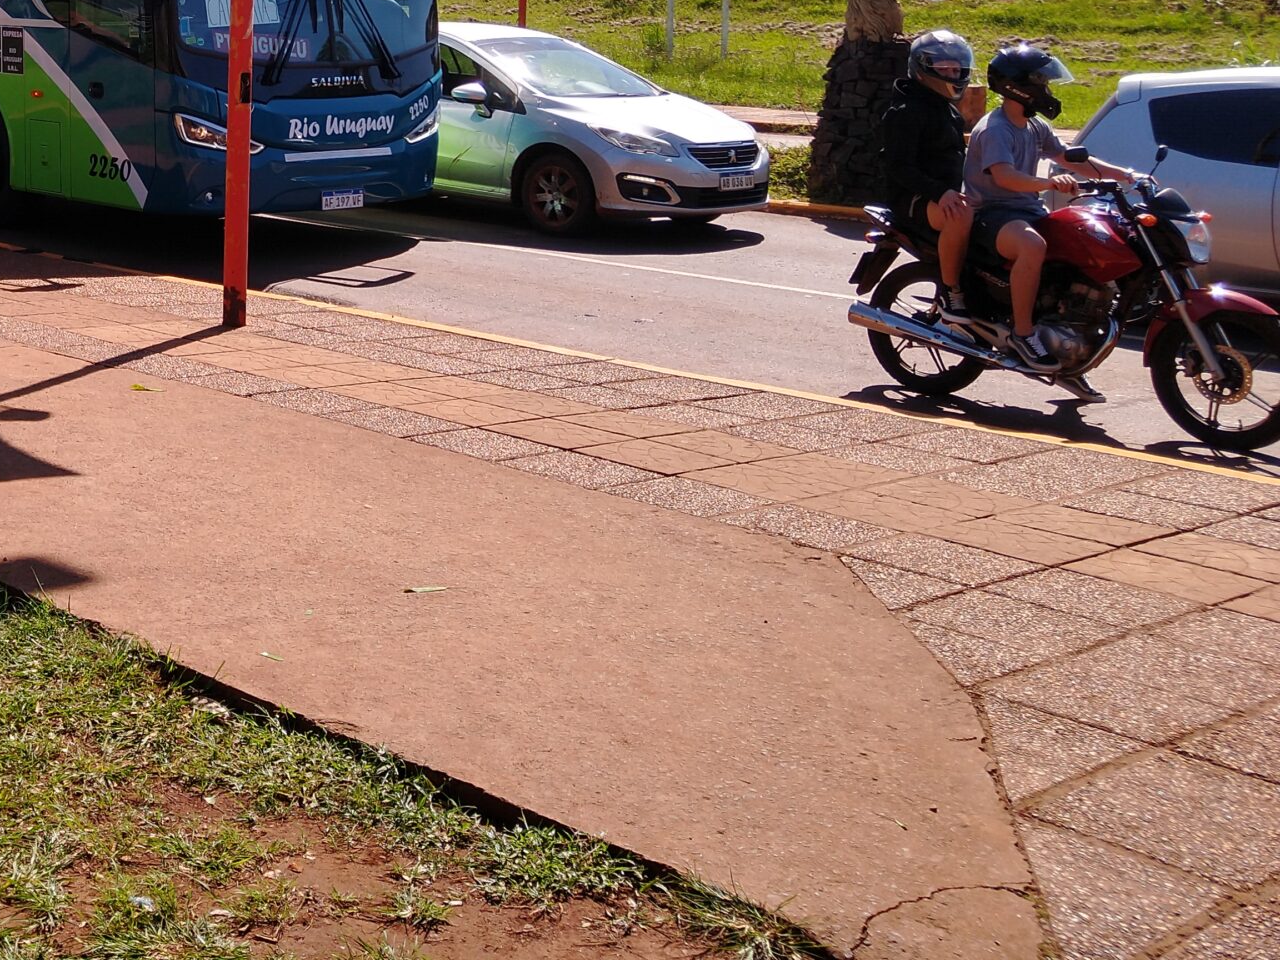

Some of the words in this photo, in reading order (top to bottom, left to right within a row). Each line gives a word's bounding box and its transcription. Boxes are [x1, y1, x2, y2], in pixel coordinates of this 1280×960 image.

[2, 30, 23, 38] EMPRESA
[253, 33, 308, 59] IGUZÚ
[311, 75, 365, 88] SALDIVIA
[408, 95, 429, 120] 2250
[288, 117, 320, 139] Rio
[325, 114, 395, 138] Uruguay
[88, 153, 131, 182] 2250
[324, 197, 334, 209] AF
[336, 196, 350, 208] 197
